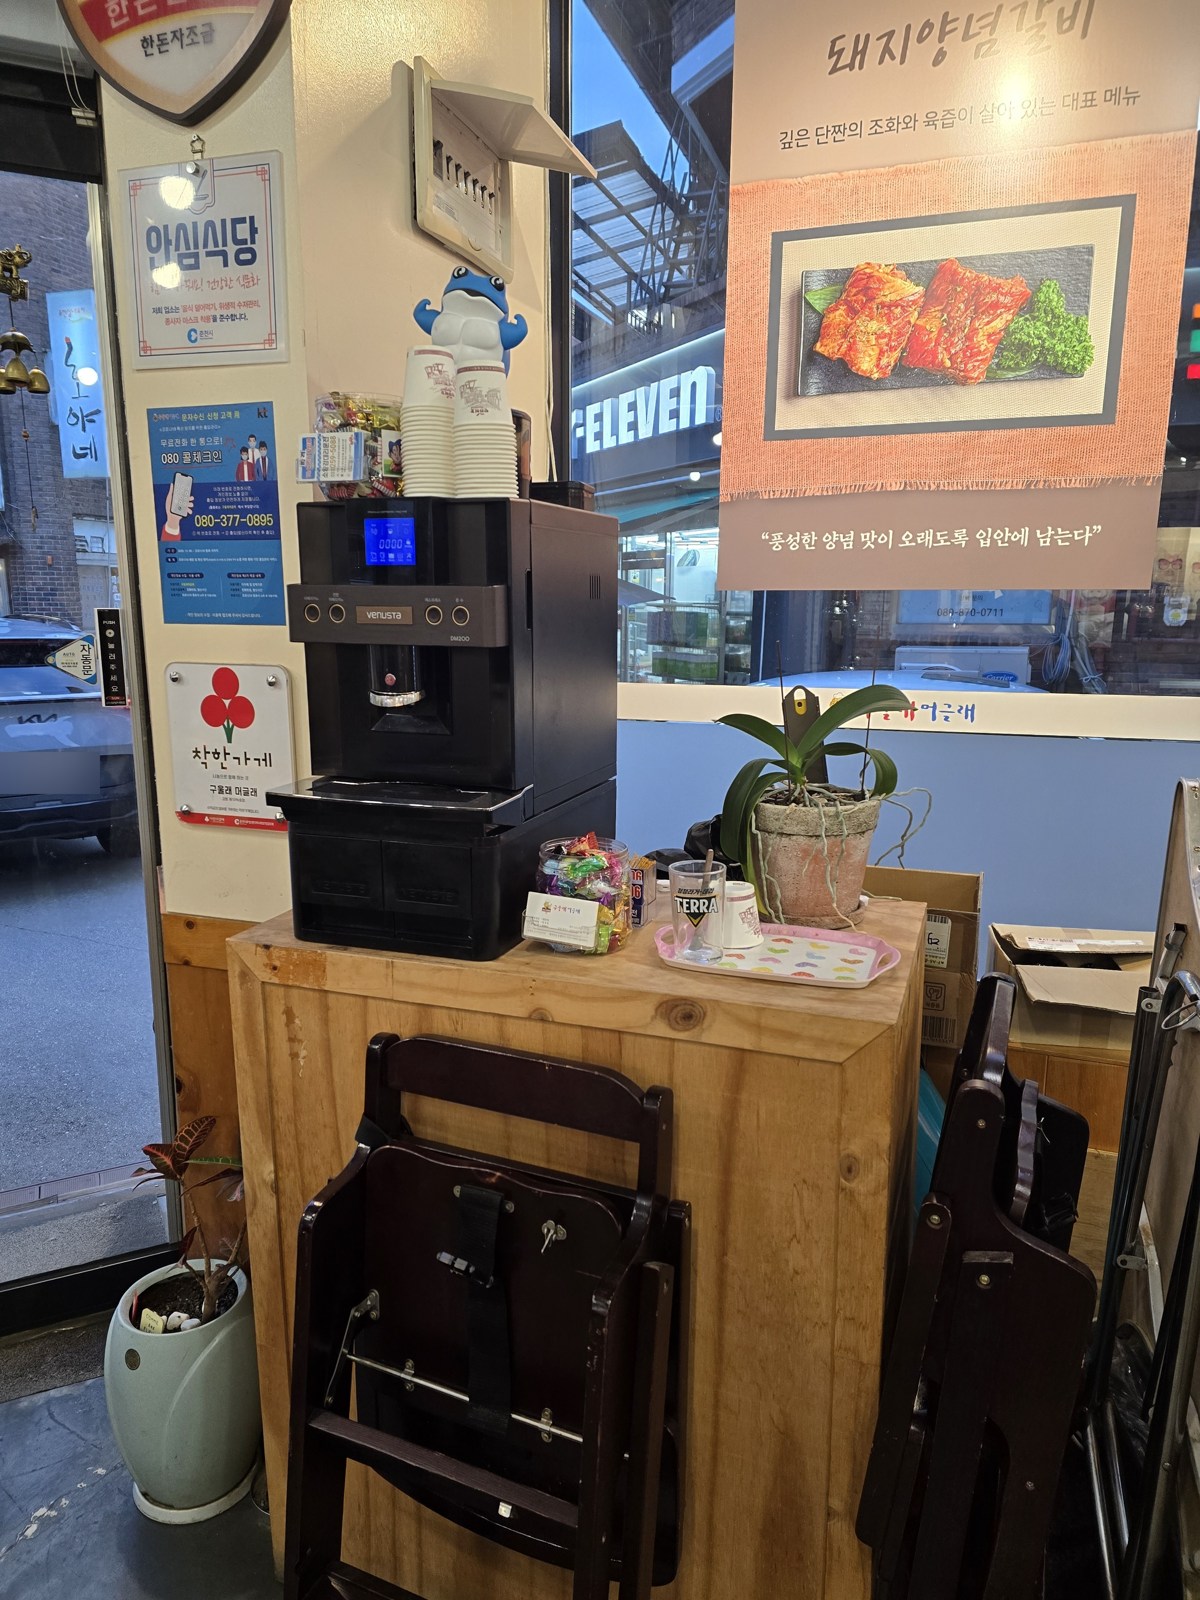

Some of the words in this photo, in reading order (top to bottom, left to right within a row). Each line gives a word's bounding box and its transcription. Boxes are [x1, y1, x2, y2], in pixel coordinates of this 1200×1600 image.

[140, 22, 215, 57] 한돈자조금
[779, 128, 810, 150] 깊은
[815, 120, 863, 145] 단짠의
[867, 112, 918, 136] 조화와
[922, 105, 973, 131] 육즙이
[1061, 90, 1098, 111] 대표
[1103, 85, 1141, 107] 메뉴
[145, 215, 259, 271] 안심식당
[257, 406, 268, 419] kt
[160, 438, 188, 448] 무료전화
[161, 453, 180, 465] 080
[182, 450, 222, 464] 콜체크인
[194, 514, 274, 527] 080-377-0895
[822, 531, 855, 550] 양념
[860, 530, 894, 550] 맛이
[898, 529, 969, 549] 오래도록
[975, 527, 1029, 548] 입안에
[80, 644, 93, 676] 자동문
[192, 745, 272, 770] 착한가게
[674, 896, 719, 914] TERRA
